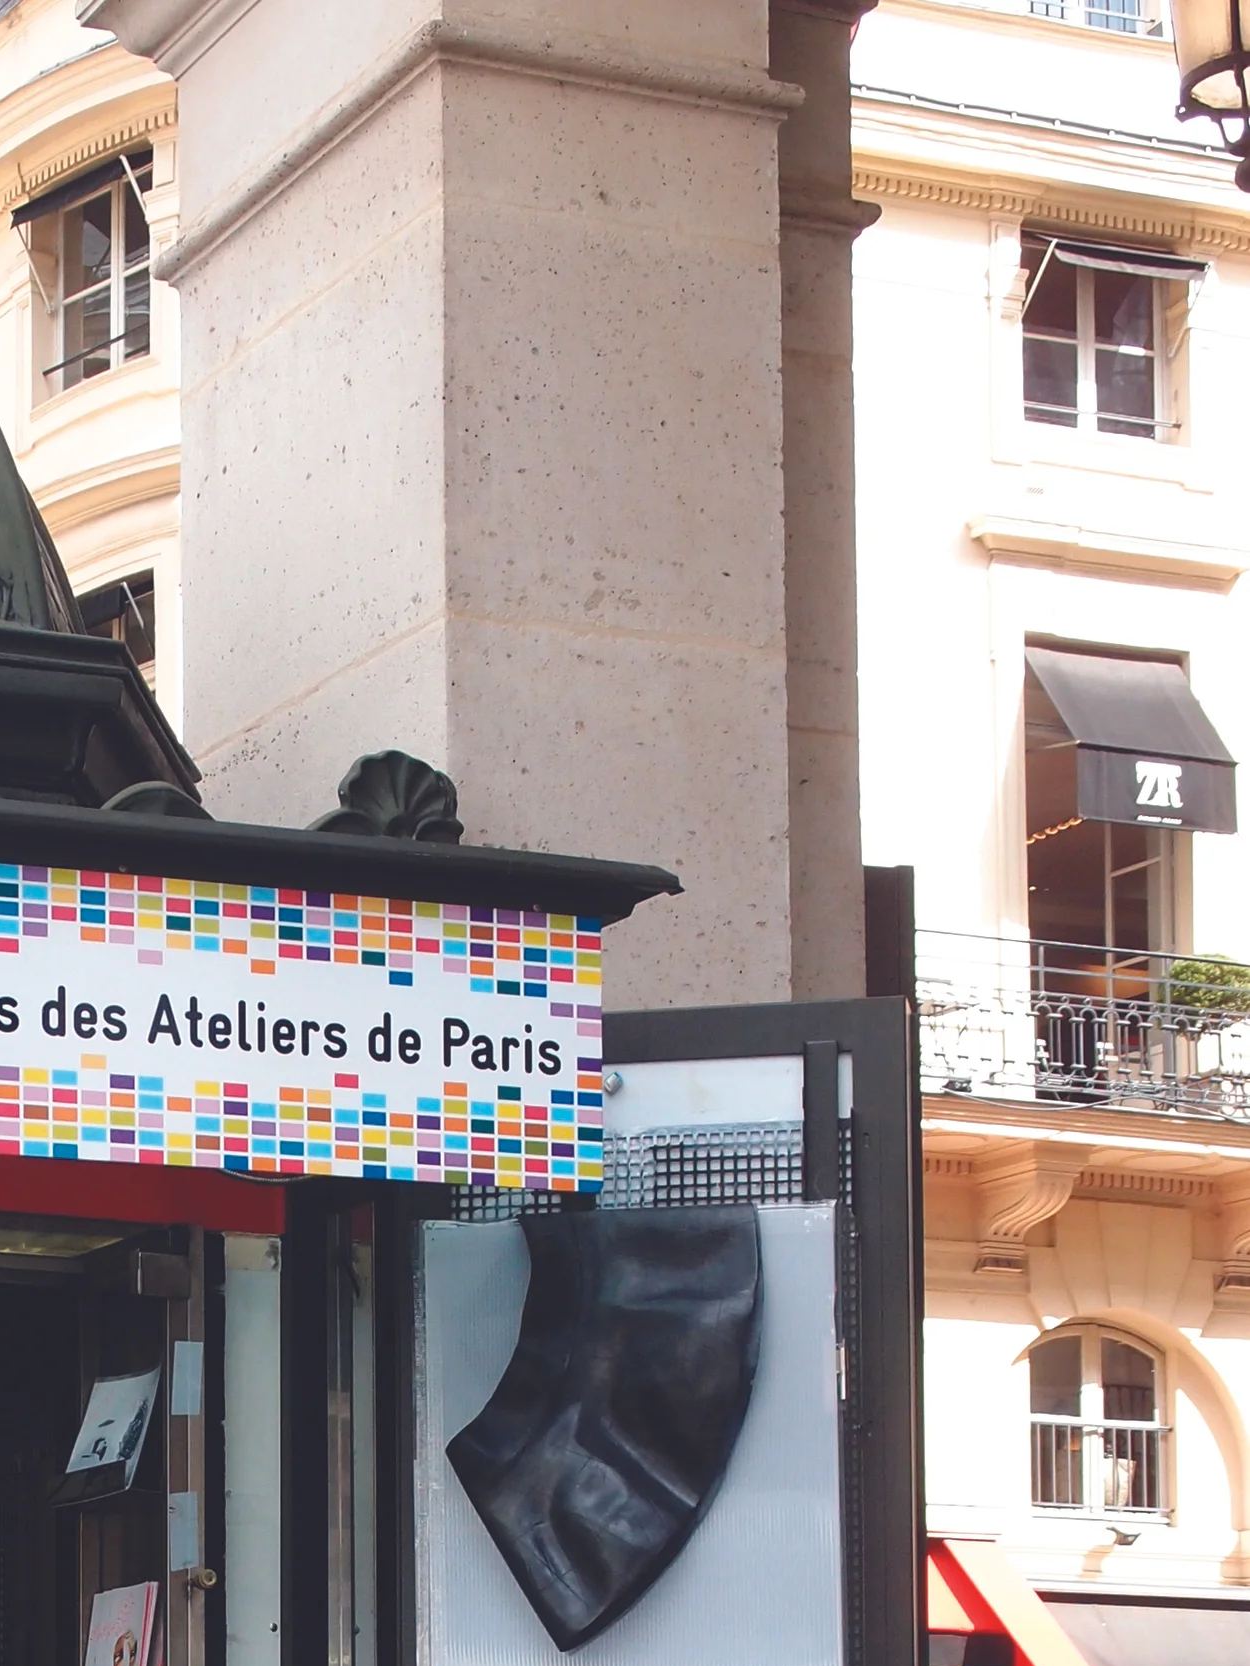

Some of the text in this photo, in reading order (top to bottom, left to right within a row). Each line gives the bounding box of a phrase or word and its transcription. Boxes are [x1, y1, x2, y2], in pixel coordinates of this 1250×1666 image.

[41, 985, 128, 1042] des
[147, 993, 348, 1059] Ateliers
[367, 1012, 422, 1065] de
[442, 1017, 562, 1076] Paris
